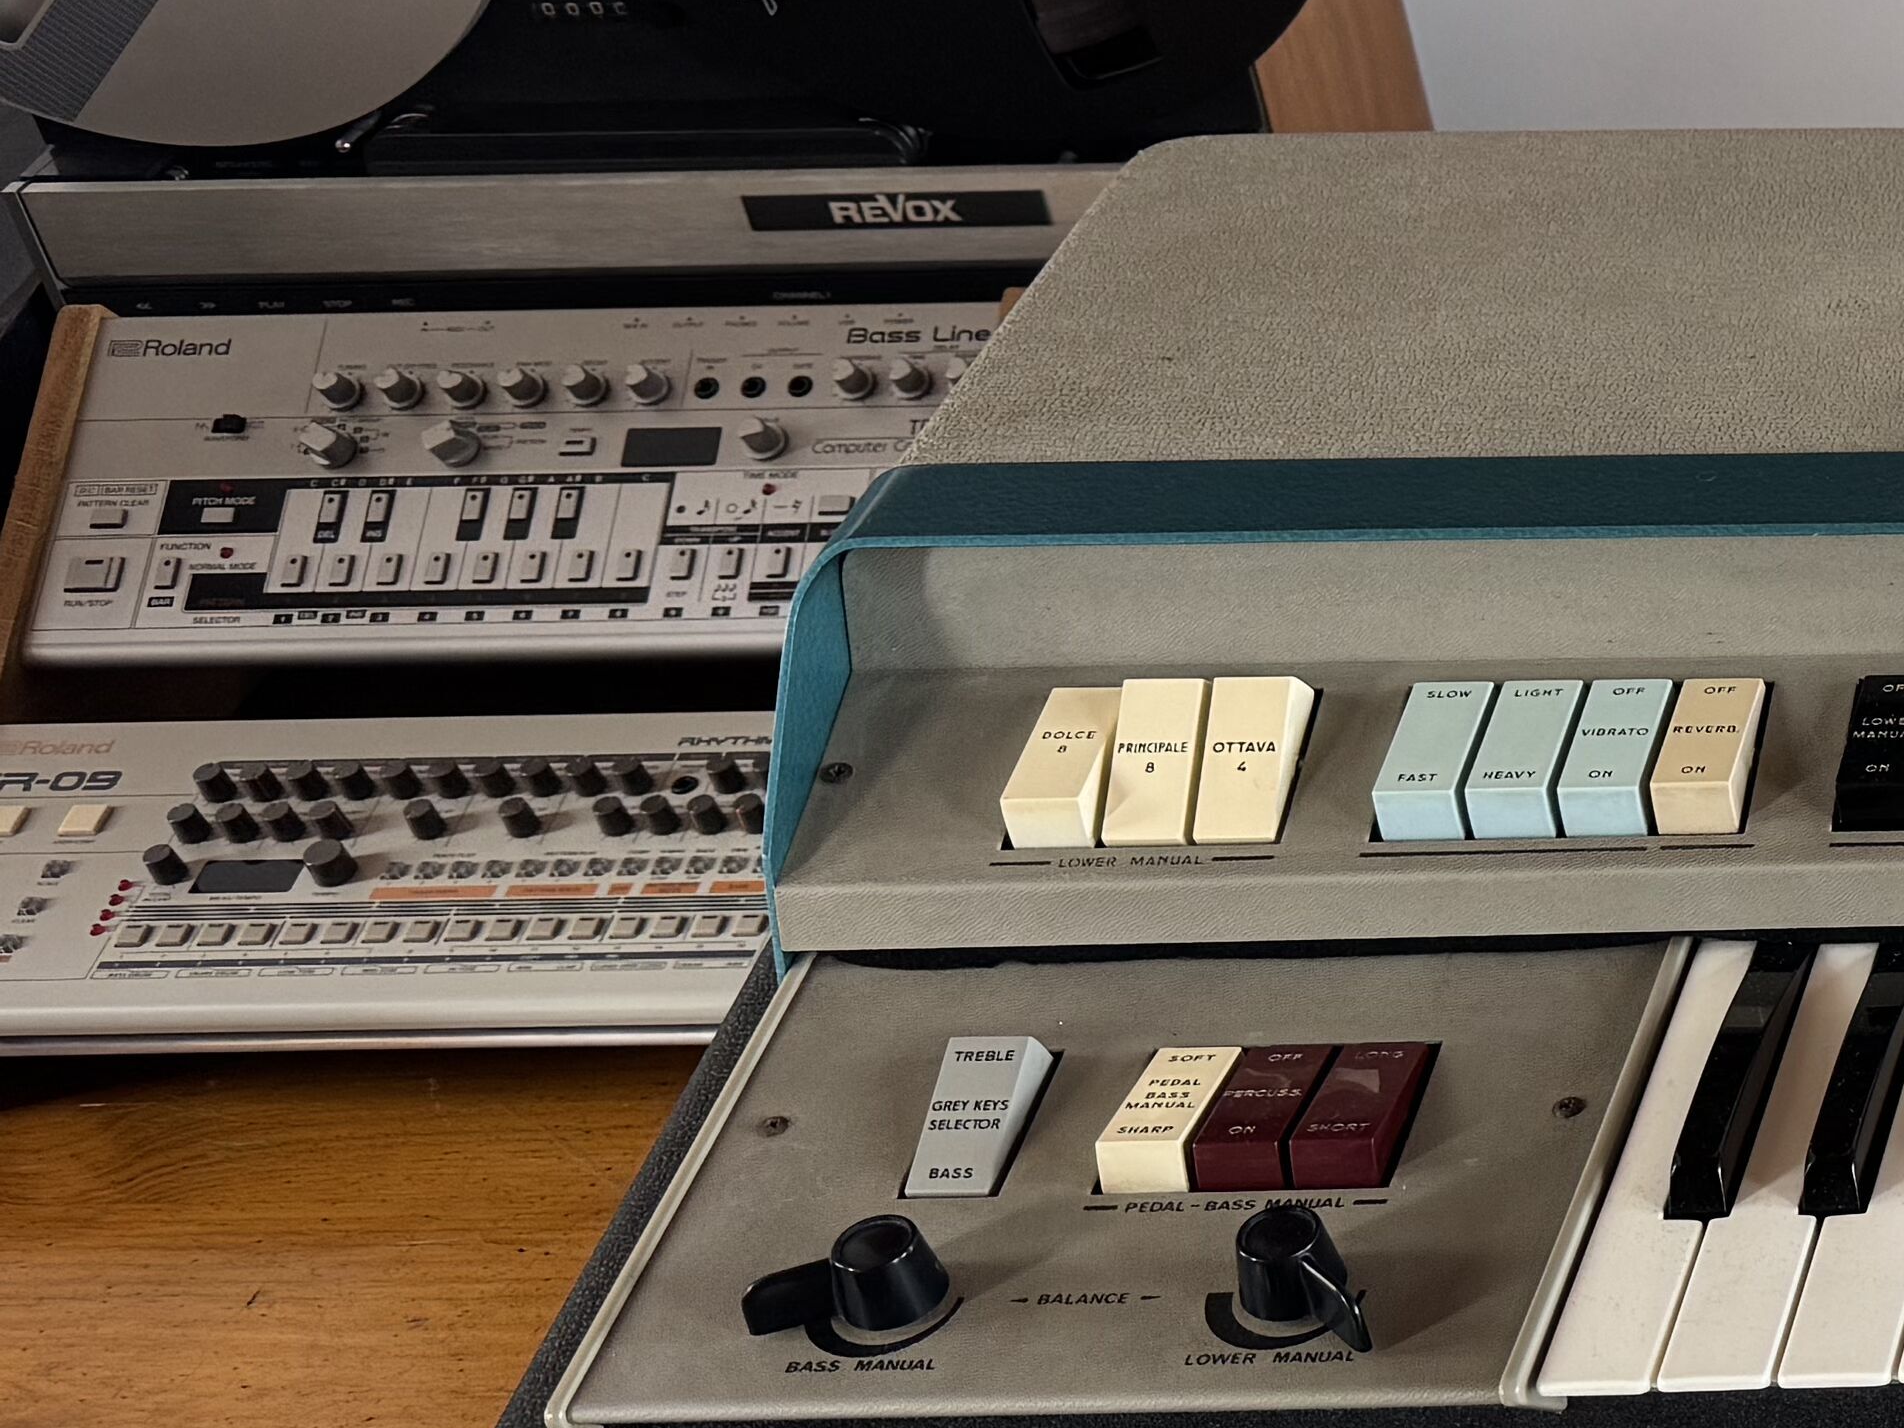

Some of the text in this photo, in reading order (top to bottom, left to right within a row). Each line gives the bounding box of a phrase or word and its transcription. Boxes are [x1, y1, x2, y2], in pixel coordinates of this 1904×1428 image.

[828, 194, 963, 224] REVOX
[846, 325, 992, 344] Bass Line
[143, 338, 232, 357] Roland
[812, 441, 889, 455] Computer
[1427, 689, 1473, 699] SLOW
[1514, 687, 1565, 698] LIGHT
[1612, 686, 1646, 696] OFF
[1704, 685, 1737, 695] OFF
[1041, 729, 1098, 740] DOLCE
[1581, 727, 1649, 737] VIBRATO
[678, 736, 772, 746] RHYTH
[20, 740, 115, 756] Roland
[1057, 744, 1068, 754] 8
[1117, 740, 1189, 755] PRINCIPALE
[1212, 740, 1276, 754] OTTAVA
[1144, 761, 1155, 774] 8
[1236, 761, 1247, 773] 4
[1681, 764, 1706, 774] ON
[1866, 763, 1890, 773] ON
[1397, 773, 1438, 783] FAST
[1483, 770, 1537, 780] HEAVY
[1588, 769, 1613, 779] ON
[1058, 854, 1204, 869] LOWER MANUAL
[954, 1049, 1016, 1062] TREBLE
[1168, 1053, 1216, 1063] SOFT
[1268, 1053, 1303, 1062] OFF
[1355, 1050, 1404, 1060] LONG
[1149, 1077, 1201, 1087] PEDAL
[1145, 1091, 1190, 1100] BASS
[932, 1099, 1010, 1112] GREY KEYS
[1125, 1101, 1195, 1110] MANUAL
[928, 1118, 1001, 1130] SELECTOR
[1306, 1122, 1370, 1132] SHORT
[1117, 1125, 1174, 1135] SHARP
[1228, 1125, 1256, 1135] ON
[929, 1167, 973, 1179] BASS
[1125, 1197, 1345, 1213] PEDAL BASS MANUAL
[1037, 1291, 1128, 1306] BALANCE
[1184, 1349, 1355, 1367] LOWER MANUAL
[785, 1357, 936, 1374] BASS MANUAL
